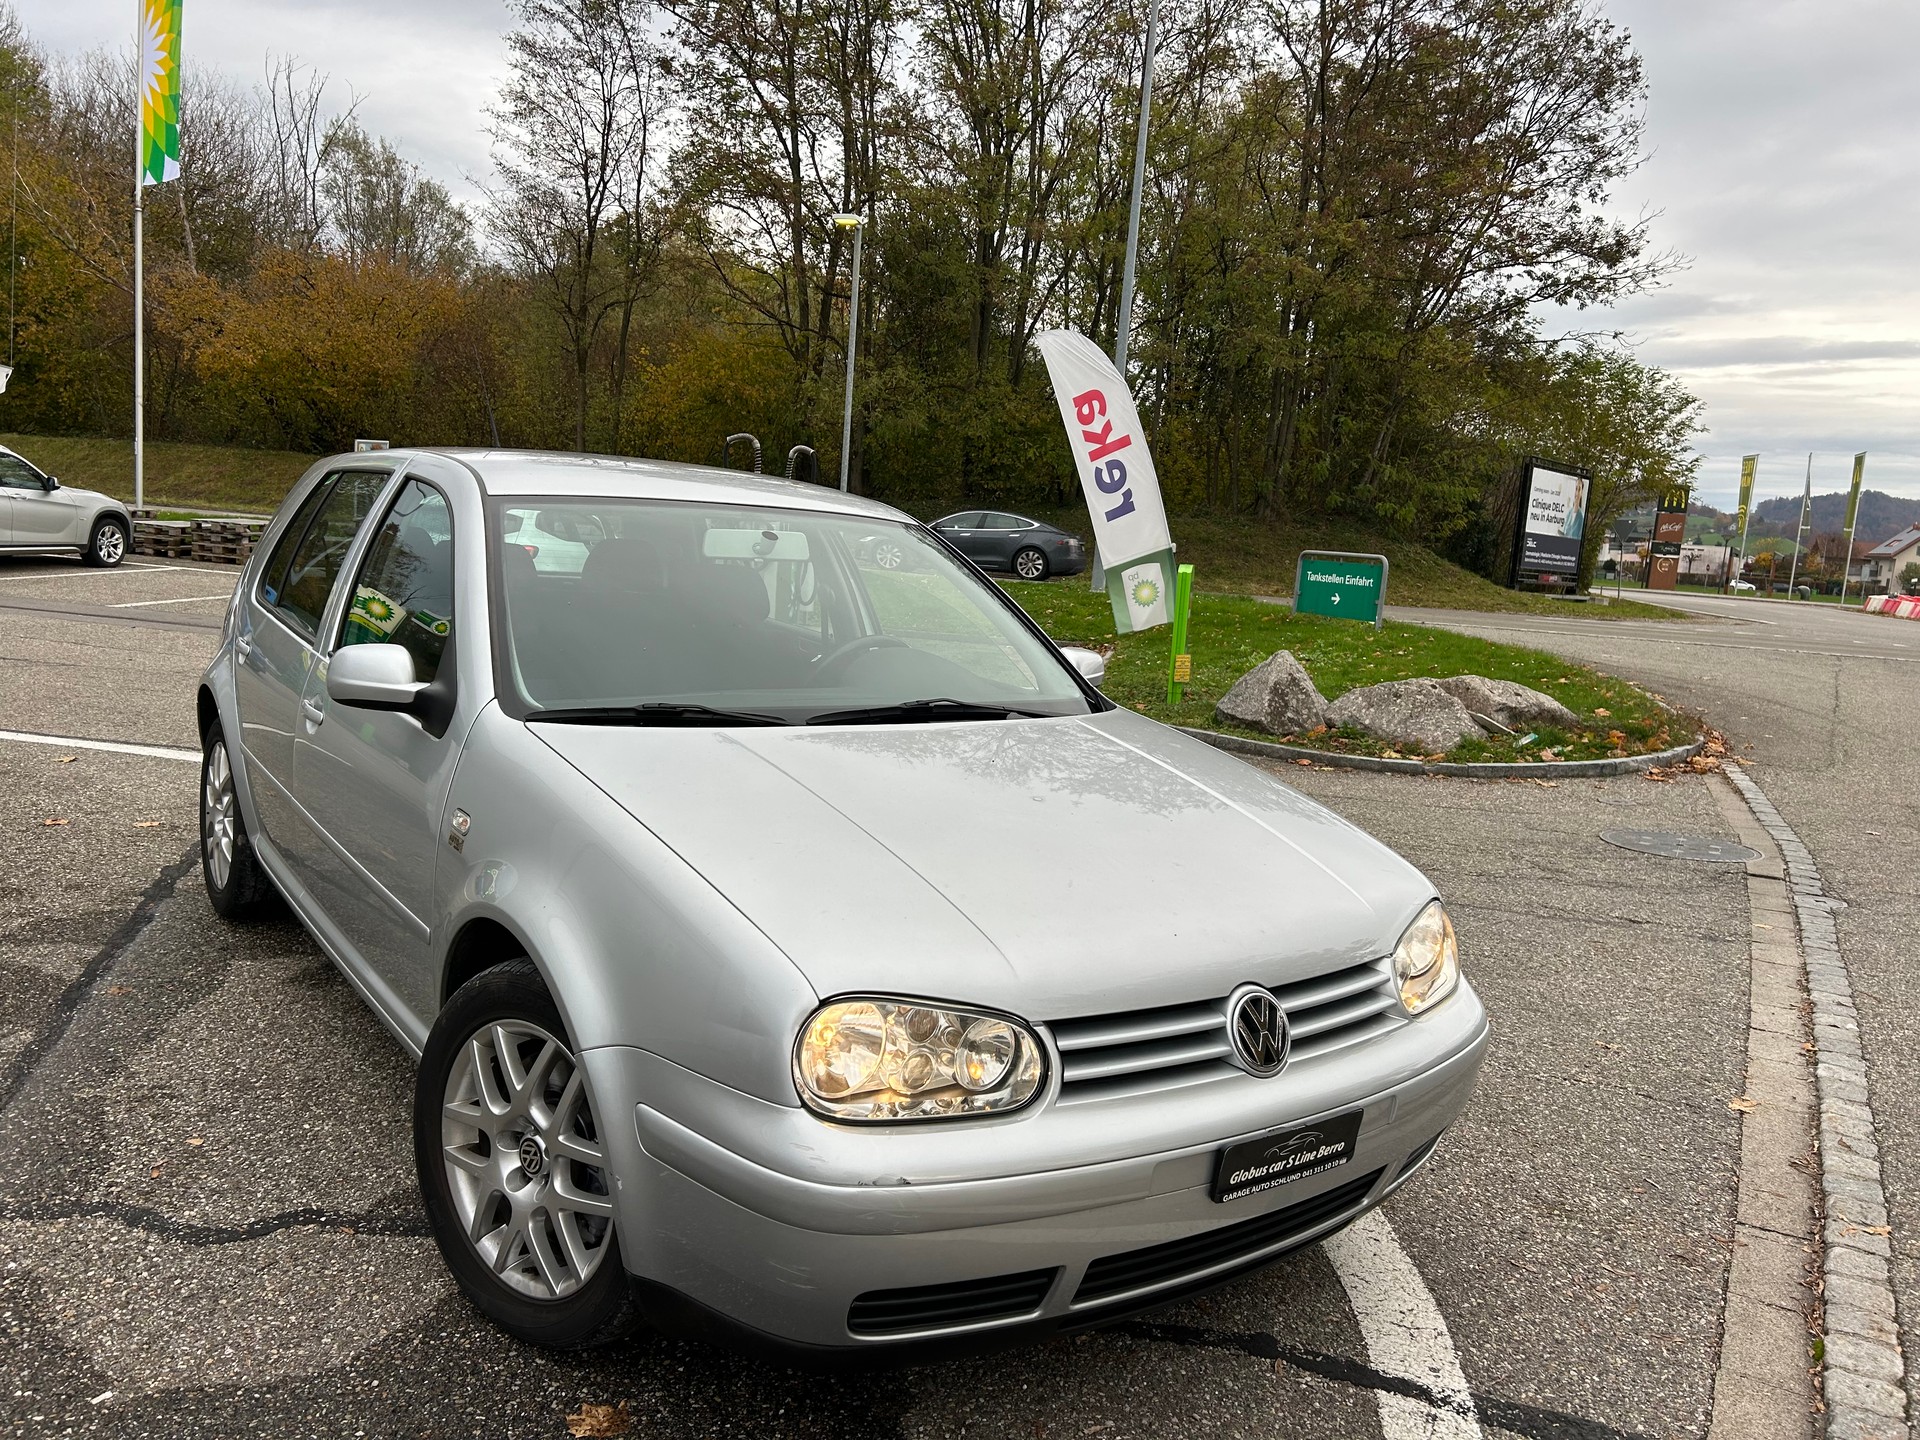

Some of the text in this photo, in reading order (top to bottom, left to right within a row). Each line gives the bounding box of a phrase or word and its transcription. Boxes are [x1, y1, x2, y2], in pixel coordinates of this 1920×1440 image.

[1532, 498, 1565, 513] Clinique DELC
[1530, 512, 1565, 527] neu in Aarburg
[1307, 571, 1374, 587] Tankstellen Einfahrt
[1229, 1141, 1345, 1185] Globus car S Line Berro
[1222, 1187, 1251, 1202] GARAGE
[1250, 1181, 1270, 1195] AUTO
[1270, 1173, 1301, 1188] SCHLUND
[1302, 1170, 1313, 1178] 041
[1313, 1166, 1324, 1174] 311
[1324, 1162, 1331, 1170] 10
[1331, 1159, 1339, 1168] 10
